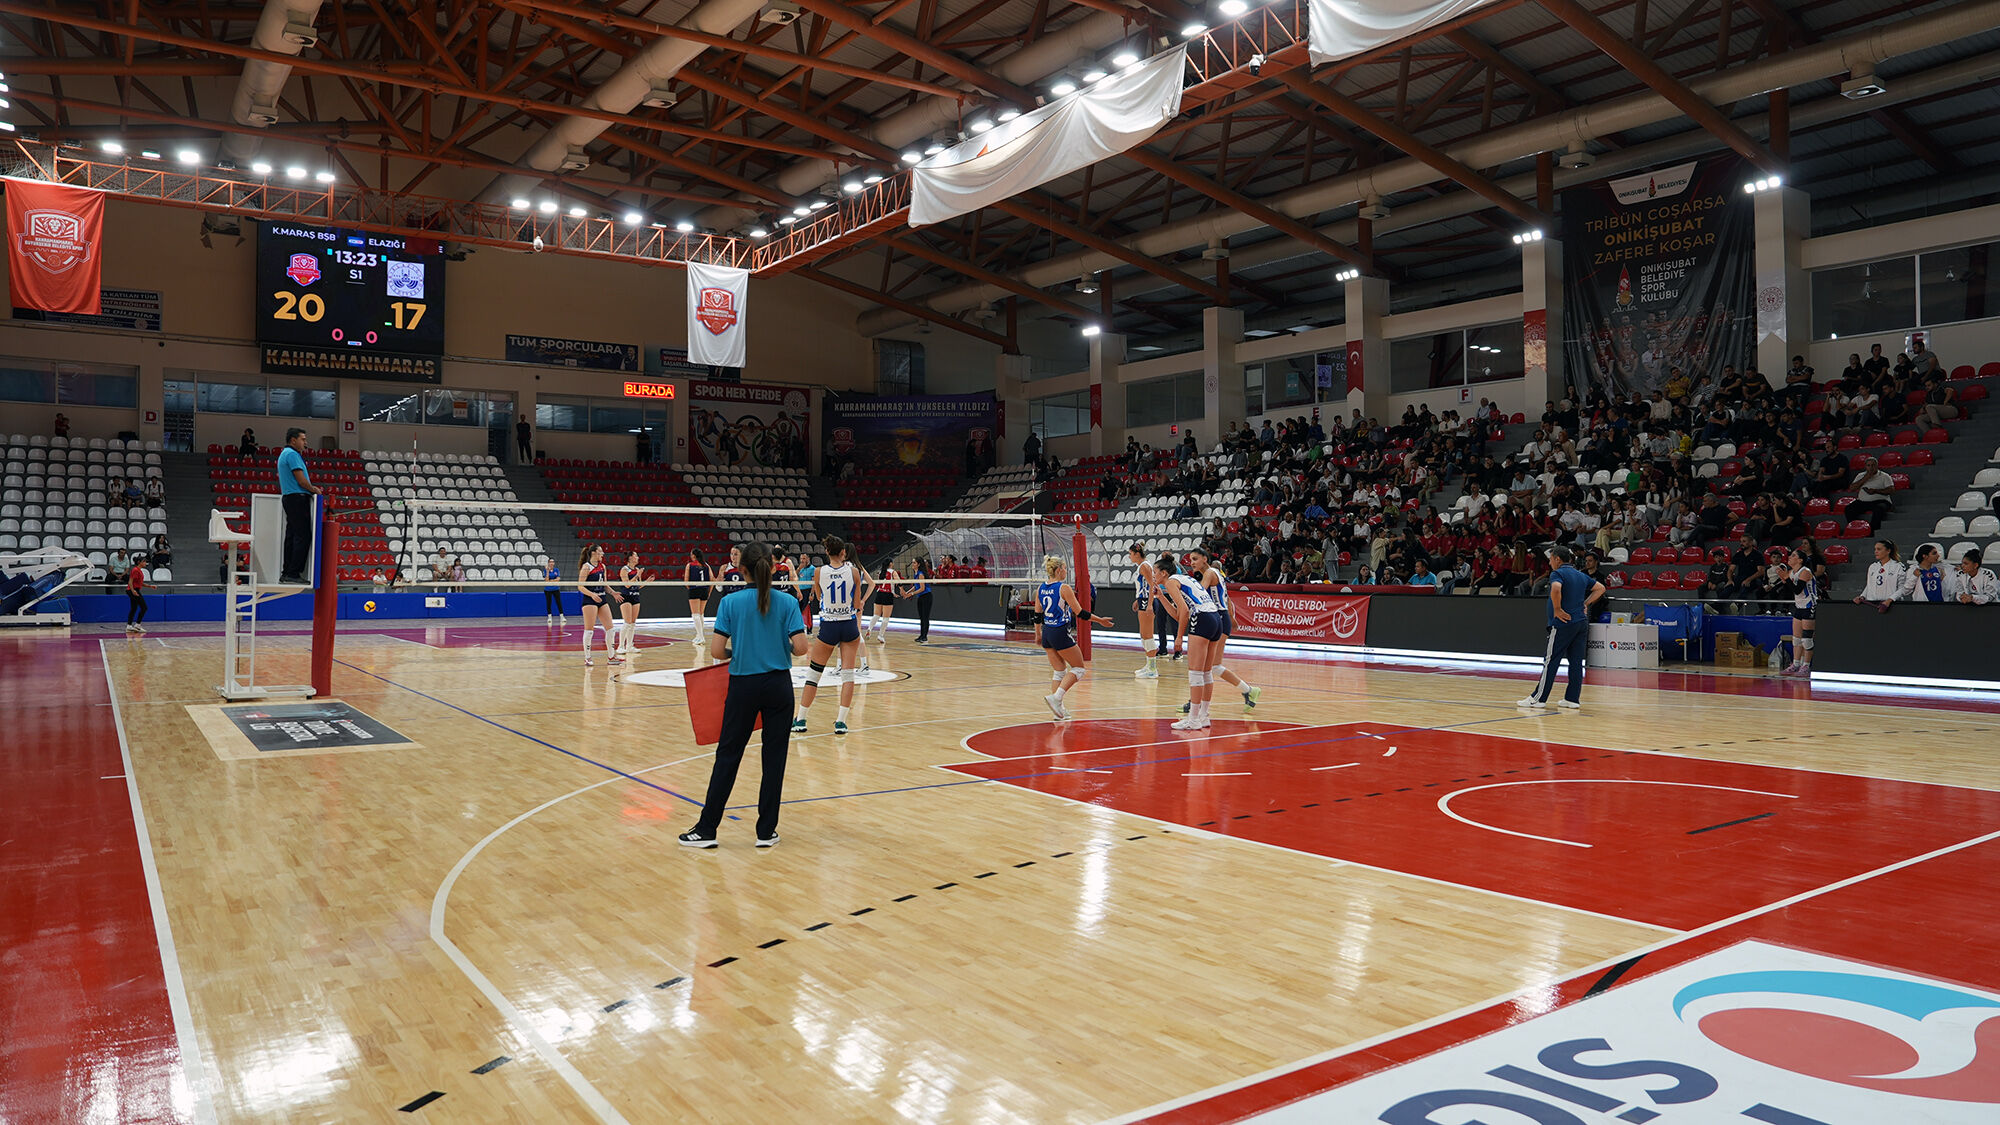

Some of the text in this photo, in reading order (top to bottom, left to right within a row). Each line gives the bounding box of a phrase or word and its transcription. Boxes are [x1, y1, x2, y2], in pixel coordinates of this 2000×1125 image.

[1585, 195, 1726, 232] TRİBÜN COŞARSA
[272, 227, 336, 241] K.MARAŞ BŞB
[1604, 217, 1704, 246] ONİKİŞUBAT
[369, 238, 400, 248] ELAZIĞ
[1595, 232, 1716, 264] ZAFERE KOŞAR
[335, 250, 377, 266] 13:23
[1640, 257, 1697, 274] ONİKİŞUBAT
[350, 270, 362, 280] S1
[1640, 269, 1685, 284] BELEDİYE
[1641, 282, 1665, 294] SPOR
[273, 291, 325, 322] 20
[391, 302, 427, 330] 17
[509, 336, 537, 347] TÜM
[540, 339, 623, 354] SPORCULARA
[266, 349, 435, 379] KAHRAMANMARAŞ
[626, 384, 673, 397] BURADA
[695, 385, 781, 401] SPOR HER YERDE
[1462, 389, 1469, 401] F
[917, 402, 956, 411] YÜKSELEN
[1313, 407, 1319, 417] E
[146, 411, 156, 421] D
[345, 421, 354, 431] D
[1171, 425, 1176, 434] E
[678, 438, 684, 446] D
[1876, 576, 1883, 586] 3
[1925, 580, 1937, 591] 13
[827, 580, 846, 604] 11
[1042, 596, 1054, 618] 2
[1246, 595, 1328, 611] TÜRKİYE VOLEYBOL
[1253, 612, 1316, 626] FEDERASYONU
